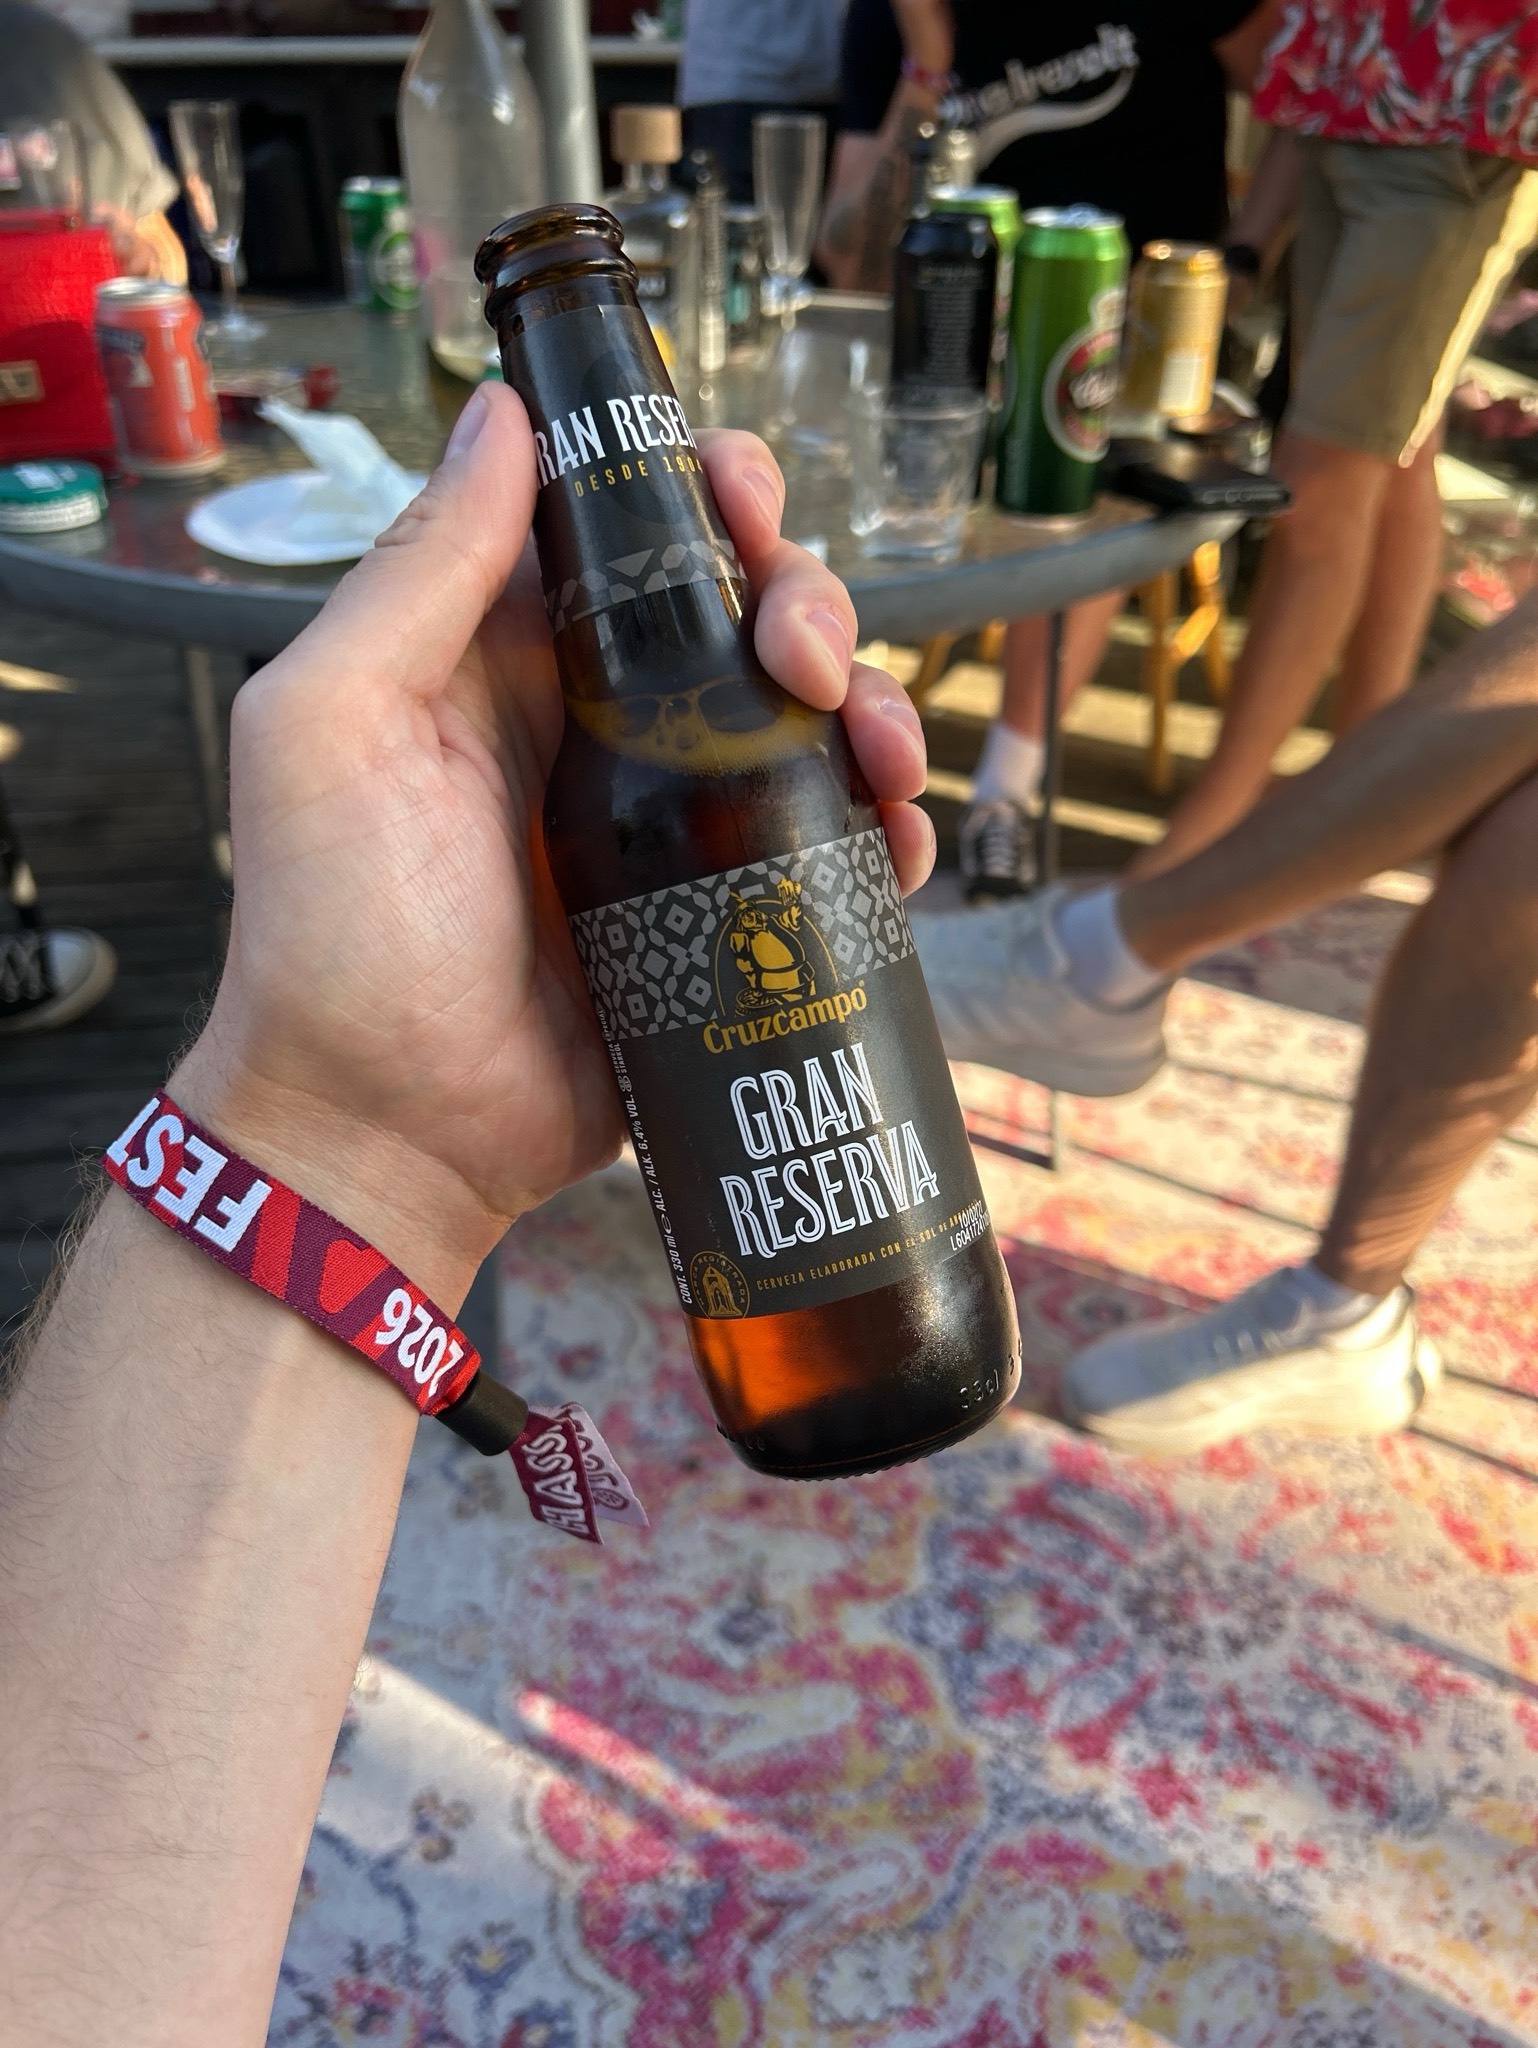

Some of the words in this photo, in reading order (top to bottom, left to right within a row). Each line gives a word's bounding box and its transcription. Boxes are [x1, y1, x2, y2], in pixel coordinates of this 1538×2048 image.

[535, 406, 606, 490] RAN
[574, 461, 649, 498] DESDE
[703, 986, 867, 1054] Cruzcampo
[626, 1094, 639, 1118] VOL.
[729, 1042, 884, 1160] GRAN
[632, 1120, 649, 1150] 6,4%
[641, 1153, 657, 1177] ALK.
[652, 1188, 667, 1212] ALC.
[719, 1119, 941, 1260] RESERVA
[664, 1234, 677, 1248] ml
[669, 1249, 684, 1272] 330
[756, 1272, 805, 1291] CERVEZA
[809, 1251, 876, 1279] ELABORADA
[880, 1241, 901, 1258] CON
[919, 1227, 937, 1244] SOL
[677, 1275, 693, 1304] CONT.
[374, 1288, 464, 1398] 2026
